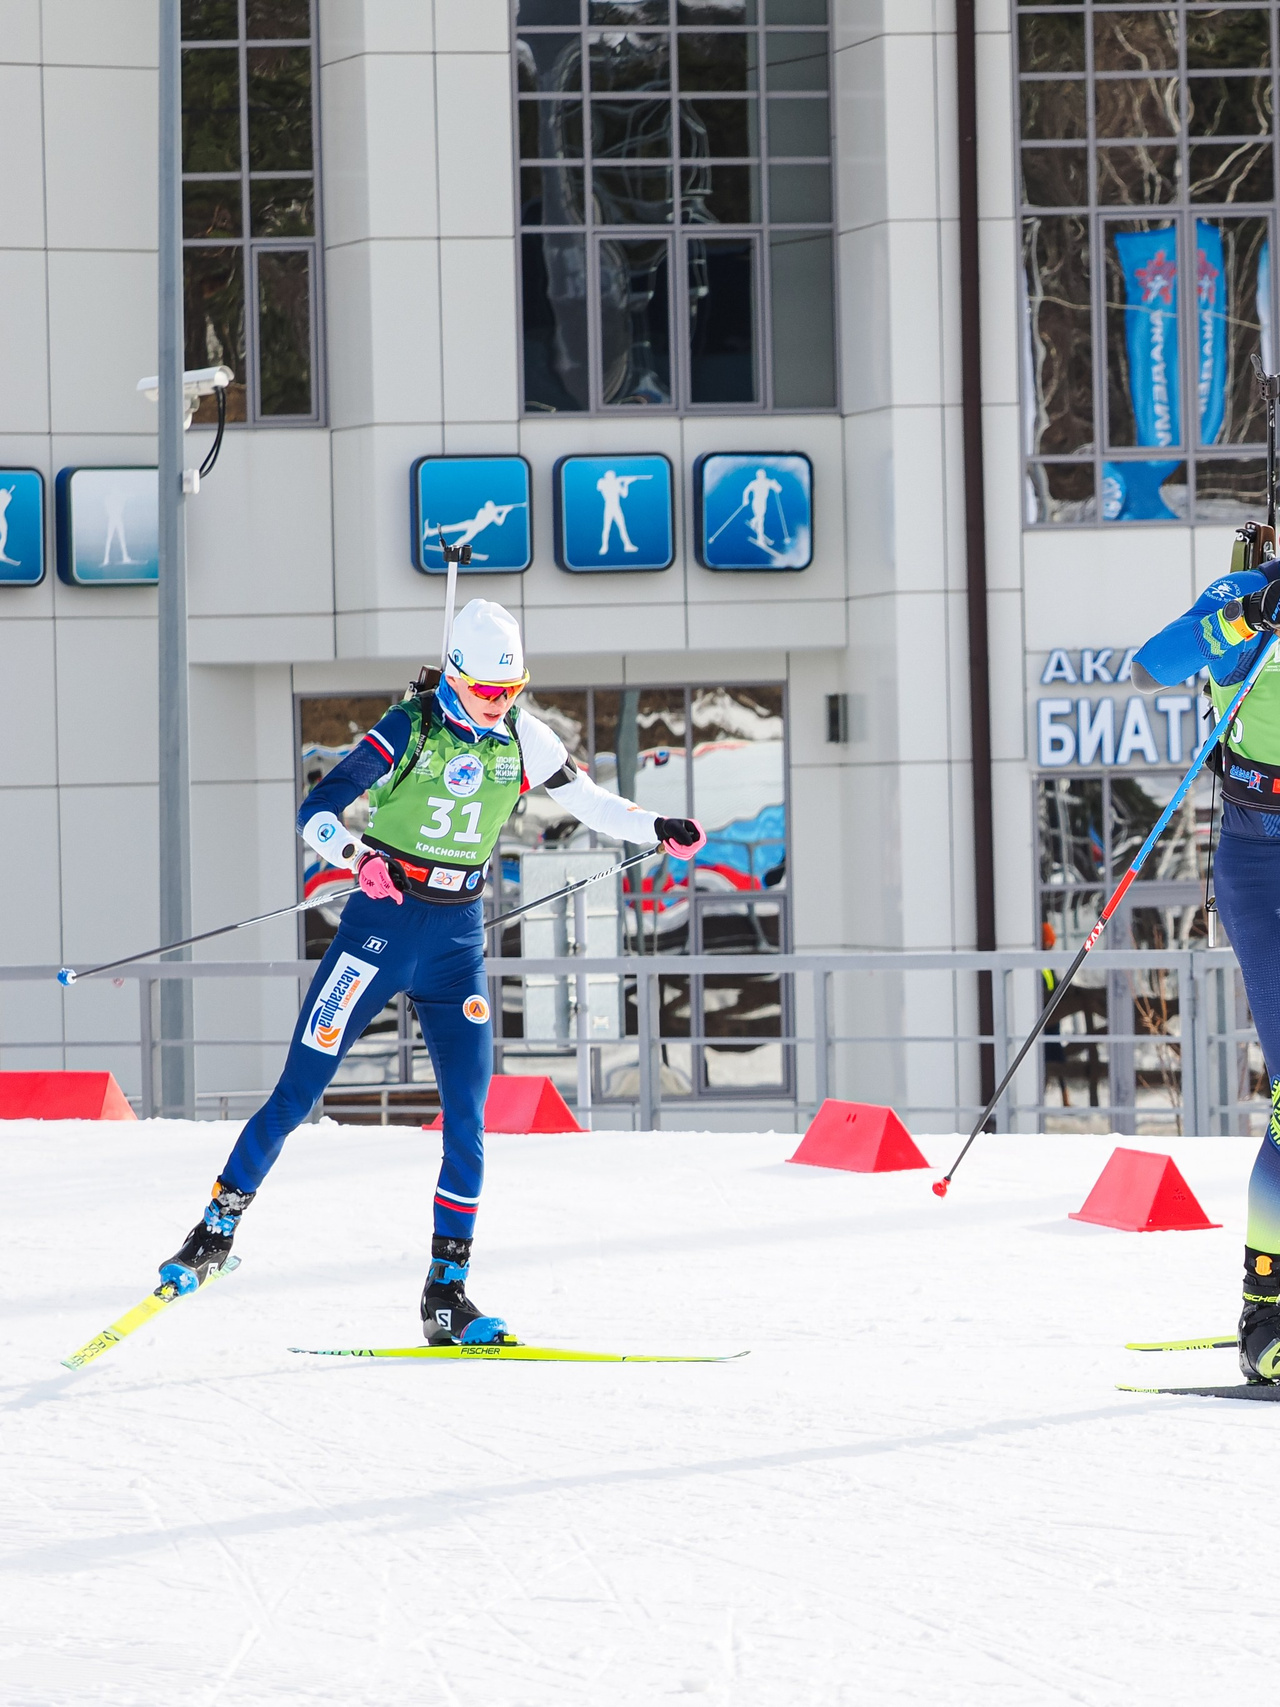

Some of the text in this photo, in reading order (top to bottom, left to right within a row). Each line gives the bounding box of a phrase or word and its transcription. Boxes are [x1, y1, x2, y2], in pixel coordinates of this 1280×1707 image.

[419, 796, 482, 843] 31
[415, 842, 478, 859] КРАСНОЯРСК
[460, 1347, 501, 1355] FISCHER
